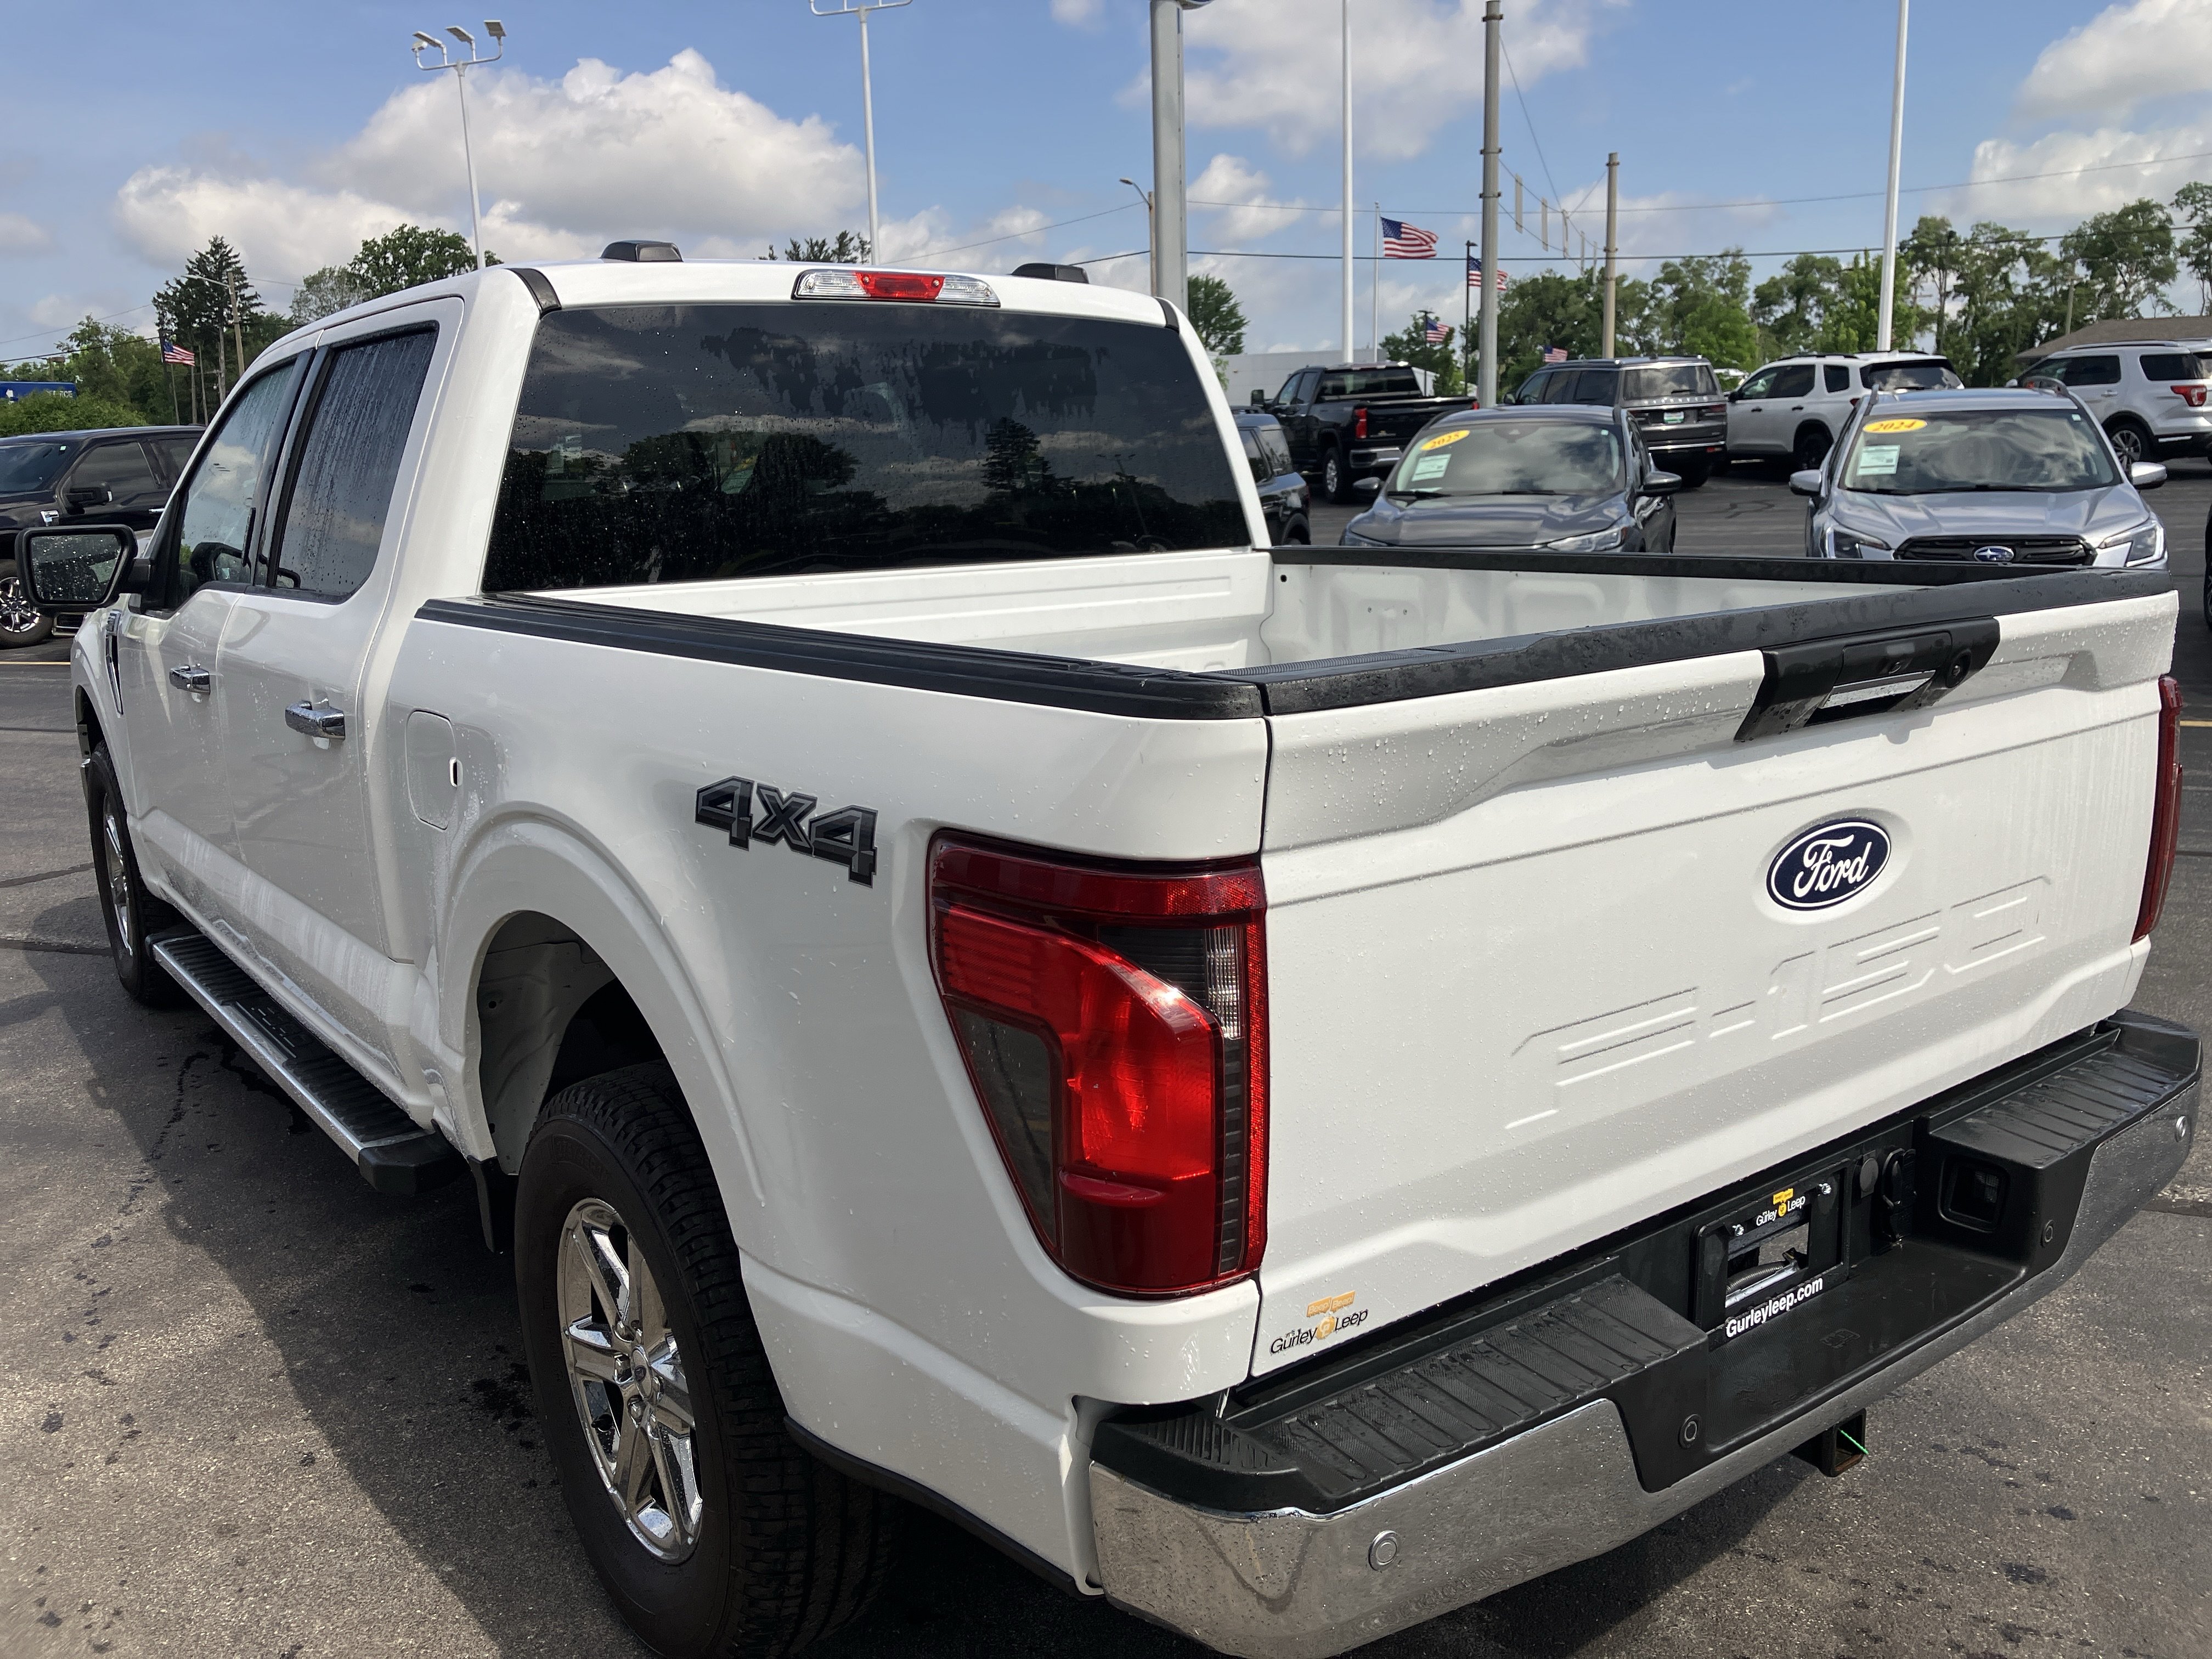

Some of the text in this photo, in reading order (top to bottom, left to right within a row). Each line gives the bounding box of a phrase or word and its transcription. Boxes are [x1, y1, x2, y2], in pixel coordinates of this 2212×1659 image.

[1872, 420, 1917, 432] 2024
[1793, 834, 1872, 898] Ford
[1505, 875, 2051, 1129] F-150
[1756, 1210, 1778, 1226] Gurley
[1787, 1196, 1805, 1212] Leep
[1270, 1309, 1369, 1354] Gurley Leep
[1725, 1277, 1823, 1338] Gurleyleep.com
